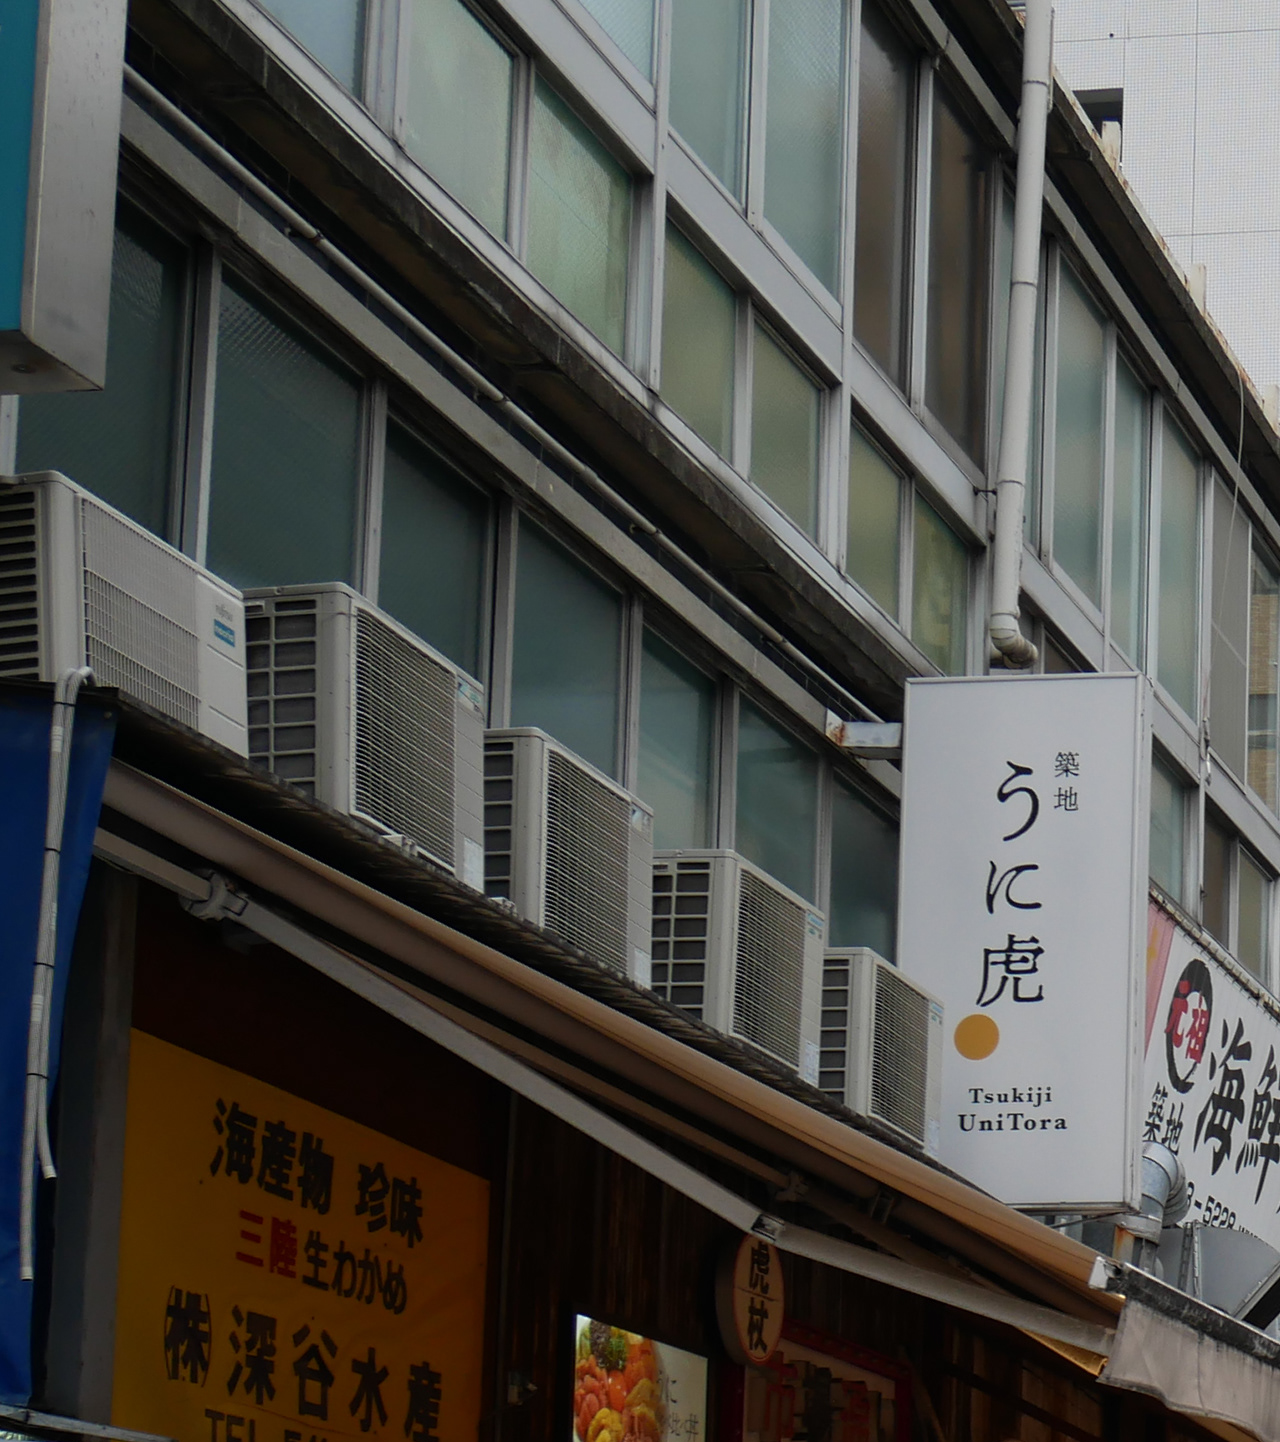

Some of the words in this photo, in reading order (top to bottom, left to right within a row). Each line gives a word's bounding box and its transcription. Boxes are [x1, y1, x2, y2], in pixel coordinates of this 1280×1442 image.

[1053, 751, 1080, 812] 築地
[976, 760, 1046, 1008] うに虎
[1164, 980, 1211, 1067] 元祖
[957, 1113, 1068, 1133] UniTora
[968, 1086, 1053, 1107] Tsukiji
[1142, 1081, 1184, 1156] 築地
[210, 1098, 334, 1216] 海産物
[353, 1161, 425, 1249] 珍味
